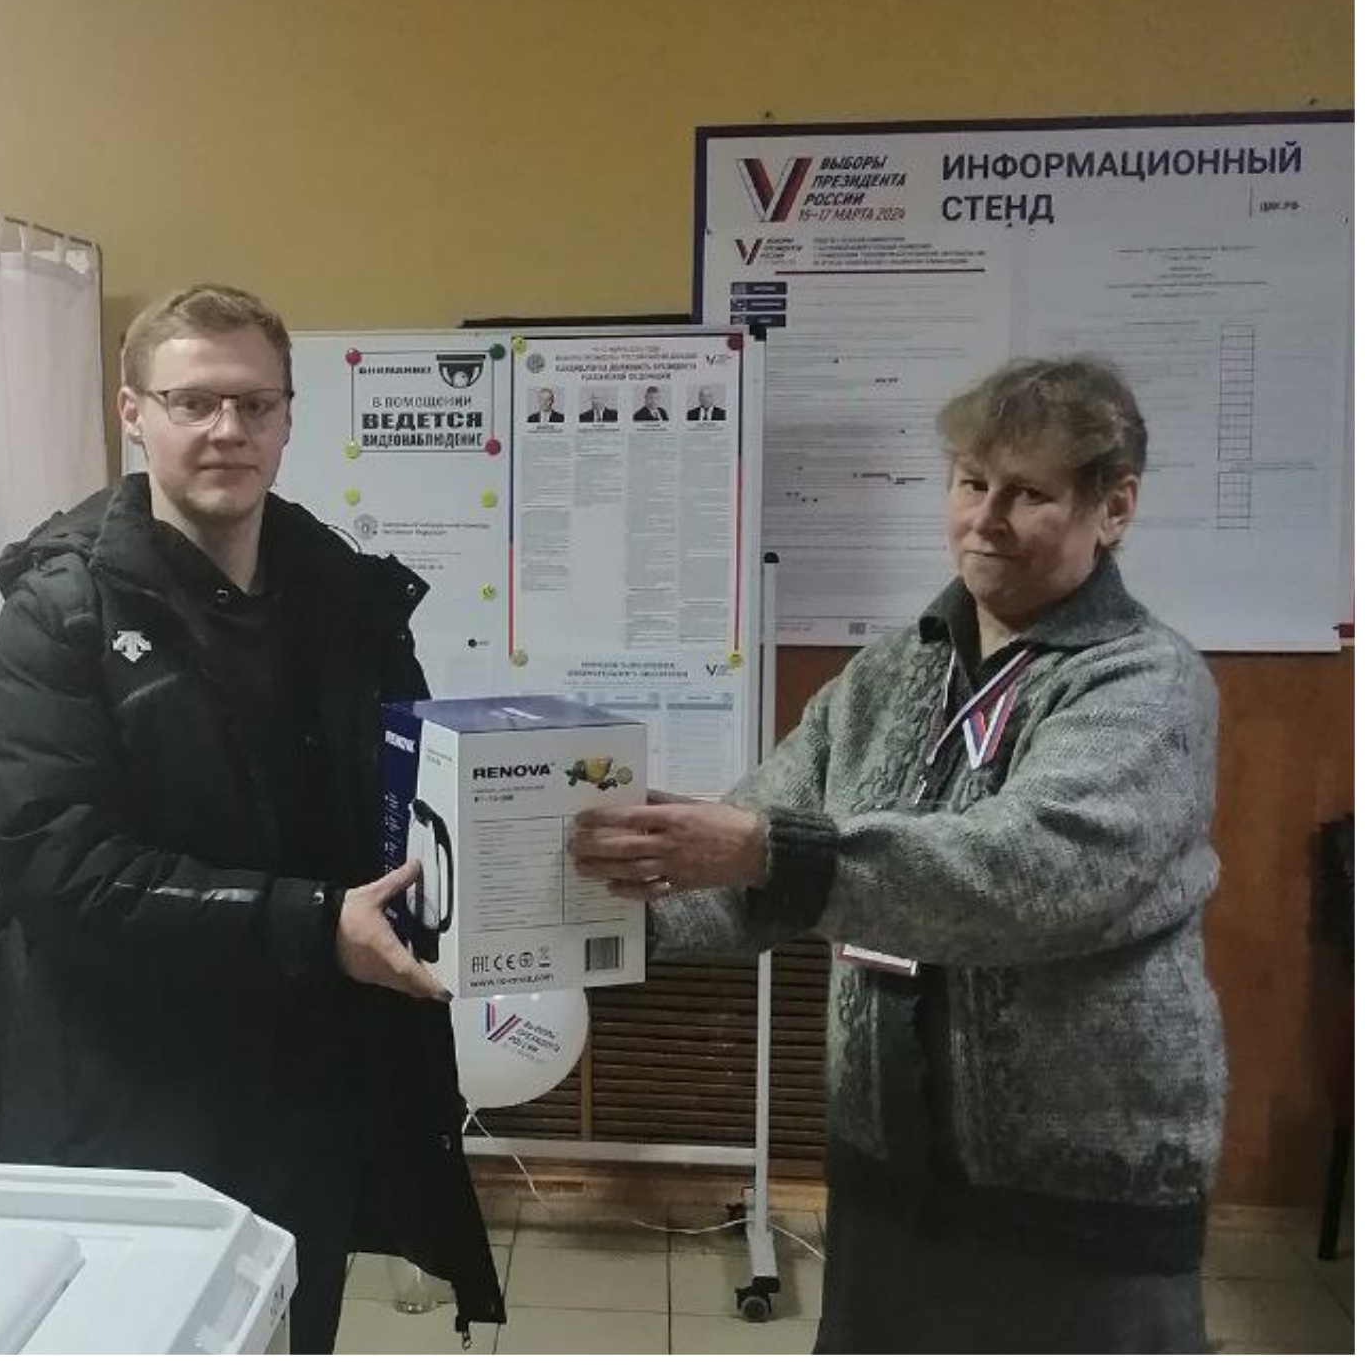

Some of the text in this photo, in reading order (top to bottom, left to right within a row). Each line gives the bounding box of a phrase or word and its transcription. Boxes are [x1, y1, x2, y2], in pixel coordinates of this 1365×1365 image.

[820, 155, 888, 171] ВЫБОРЫ
[941, 141, 1303, 181] ИНФОРМАЦИОННЫЙ
[812, 173, 908, 188] ПРЕЗИДЕНТА
[802, 192, 866, 207] РОССИИ
[832, 208, 874, 221] МАРТА
[941, 194, 1055, 224] СТЕНД
[362, 412, 482, 431] ВЕДЕТСЯ
[362, 433, 482, 449] ВИДЕОНАБЛЮДЕНИЕ
[472, 764, 551, 780] RENOVA
